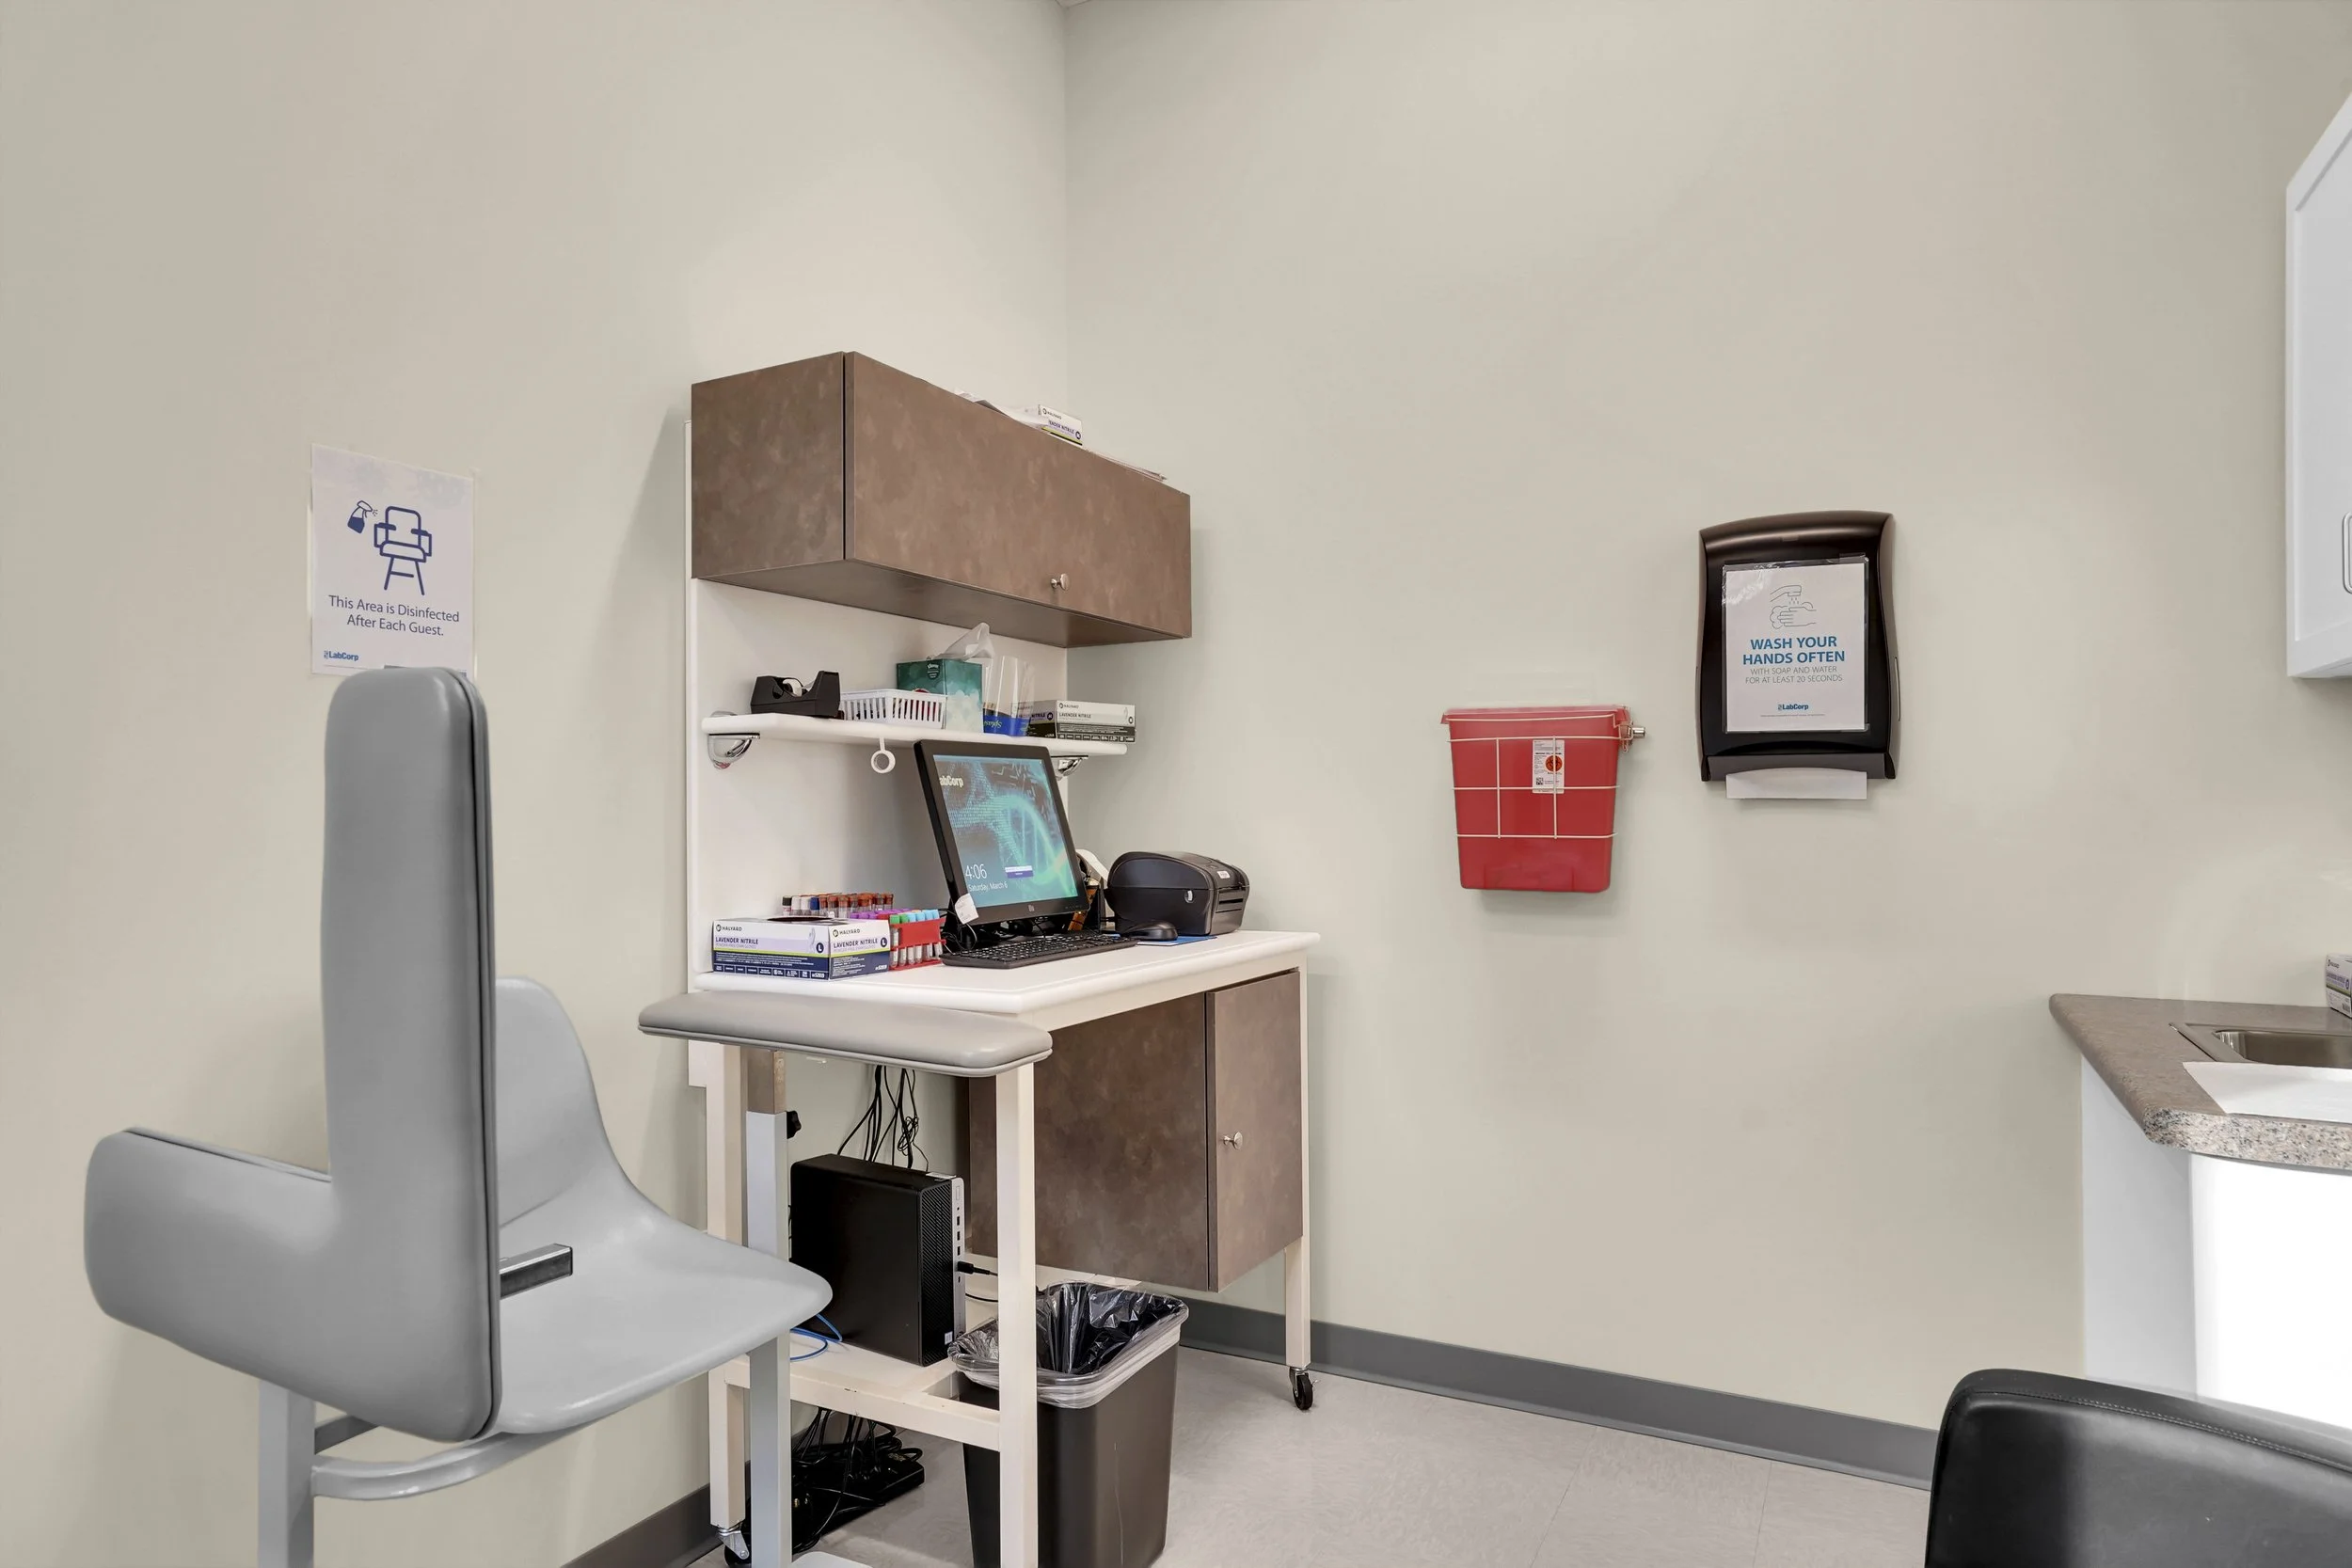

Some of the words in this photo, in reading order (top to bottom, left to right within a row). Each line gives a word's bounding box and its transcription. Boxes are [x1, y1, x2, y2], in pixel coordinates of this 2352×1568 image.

[328, 594, 354, 610] This
[357, 599, 383, 613] Area
[386, 603, 395, 615] is
[398, 604, 460, 623] Disinfected
[346, 614, 376, 628] After
[379, 618, 405, 632] Each
[408, 622, 444, 637] Guest.
[1750, 638, 1792, 650] WASH
[1797, 636, 1837, 648] YOUR
[328, 650, 359, 661] LabCorp
[1742, 653, 1793, 665] HANDS
[1797, 651, 1845, 663] OFTEN
[1812, 665, 1837, 673] WATER
[1772, 675, 1795, 684] LEAST
[1807, 674, 1843, 683] SECONDS
[965, 863, 987, 879] 4:06
[968, 884, 990, 893] Saturday,
[833, 940, 859, 949] LAVENDER
